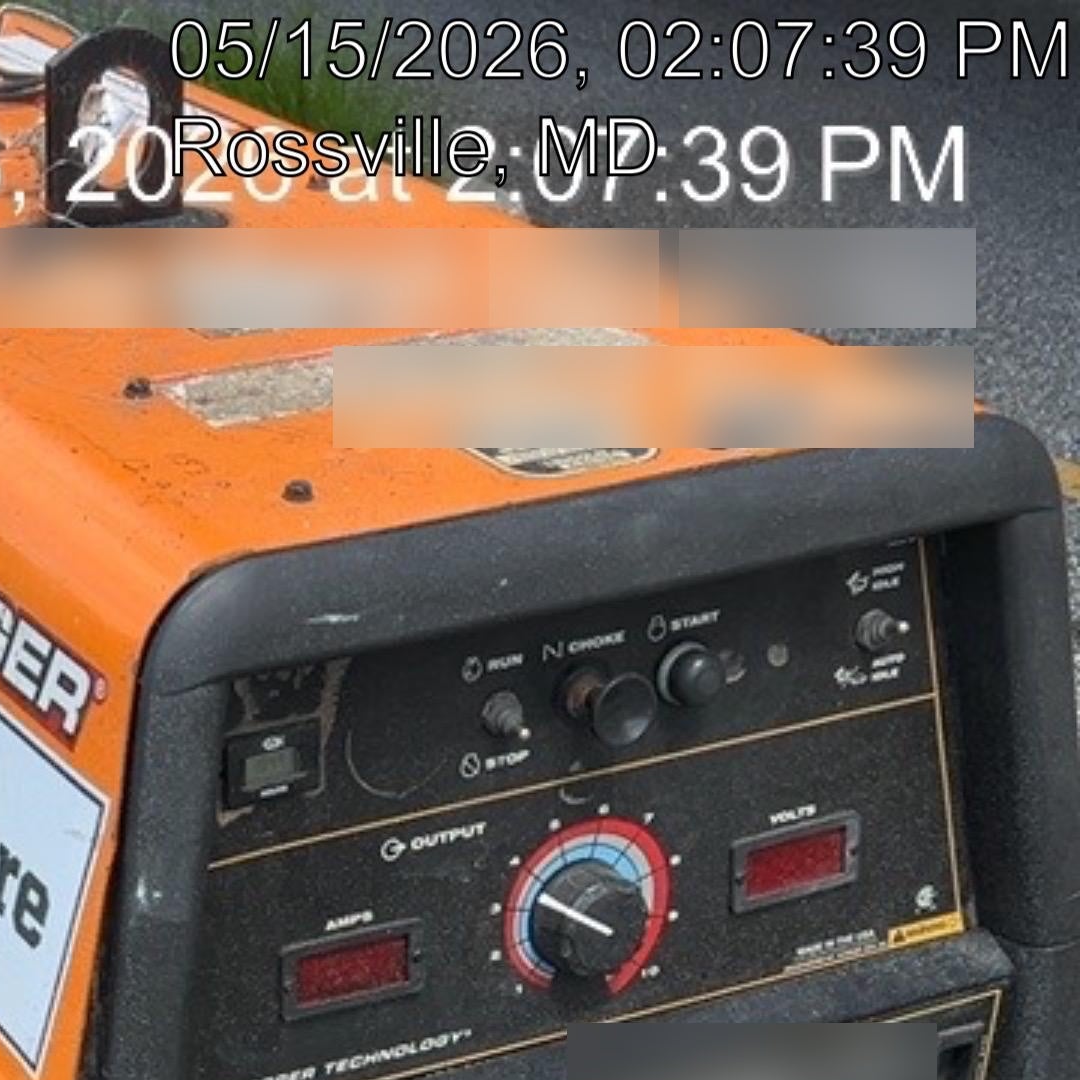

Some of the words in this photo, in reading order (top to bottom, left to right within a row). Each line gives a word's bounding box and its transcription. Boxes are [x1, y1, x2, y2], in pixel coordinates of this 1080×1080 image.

[769, 803, 817, 825] VOLTS
[409, 821, 487, 851] OUTPUT
[324, 910, 374, 932] AMPS
